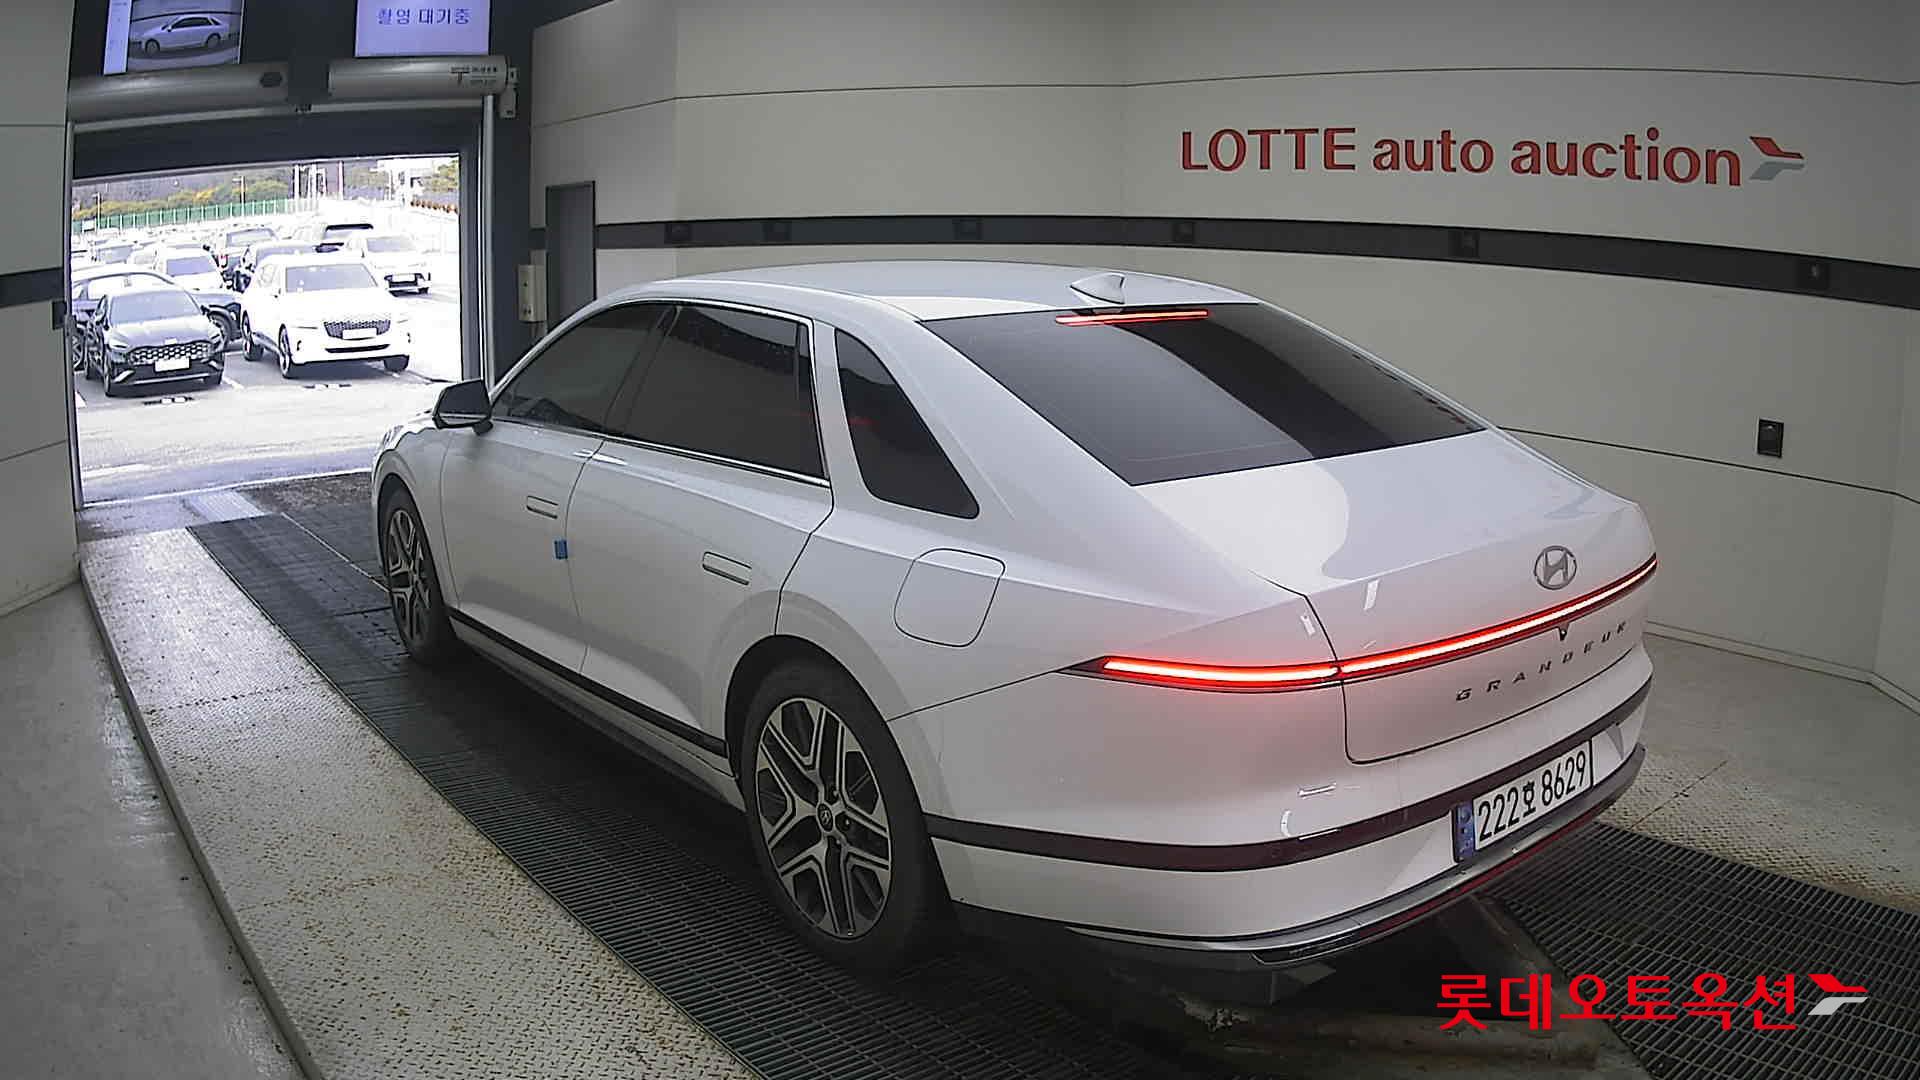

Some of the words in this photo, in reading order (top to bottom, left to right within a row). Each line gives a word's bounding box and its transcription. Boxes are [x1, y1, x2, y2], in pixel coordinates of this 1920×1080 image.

[418, 8, 470, 25] 대기중
[1182, 127, 1356, 171] LOTTE
[1373, 129, 1494, 173] auto
[1511, 127, 1741, 187] auction
[1478, 781, 1536, 841] 222호
[1541, 750, 1586, 806] 8629
